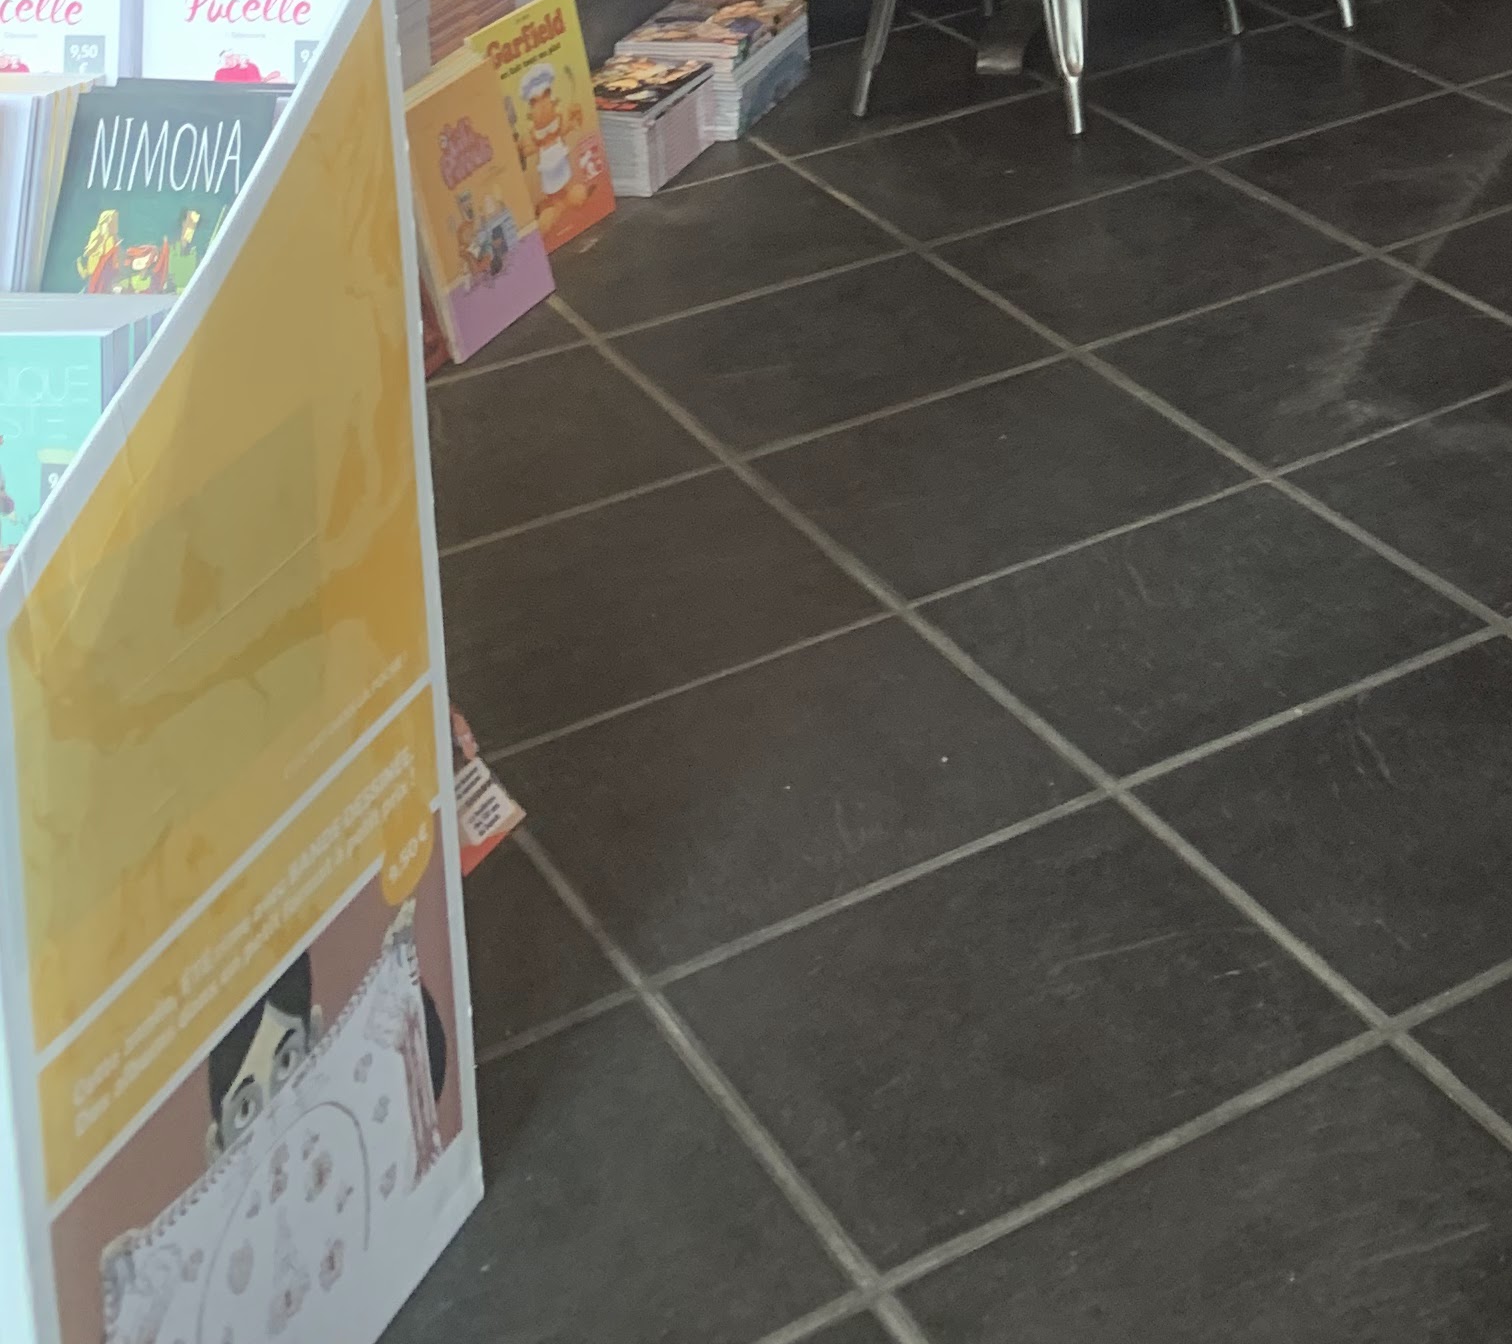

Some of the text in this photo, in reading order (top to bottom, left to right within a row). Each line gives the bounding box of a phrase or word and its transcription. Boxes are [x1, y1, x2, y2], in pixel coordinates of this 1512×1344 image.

[69, 45, 98, 60] 9,50
[486, 7, 566, 70] Garfield
[87, 115, 242, 194] NIMONA
